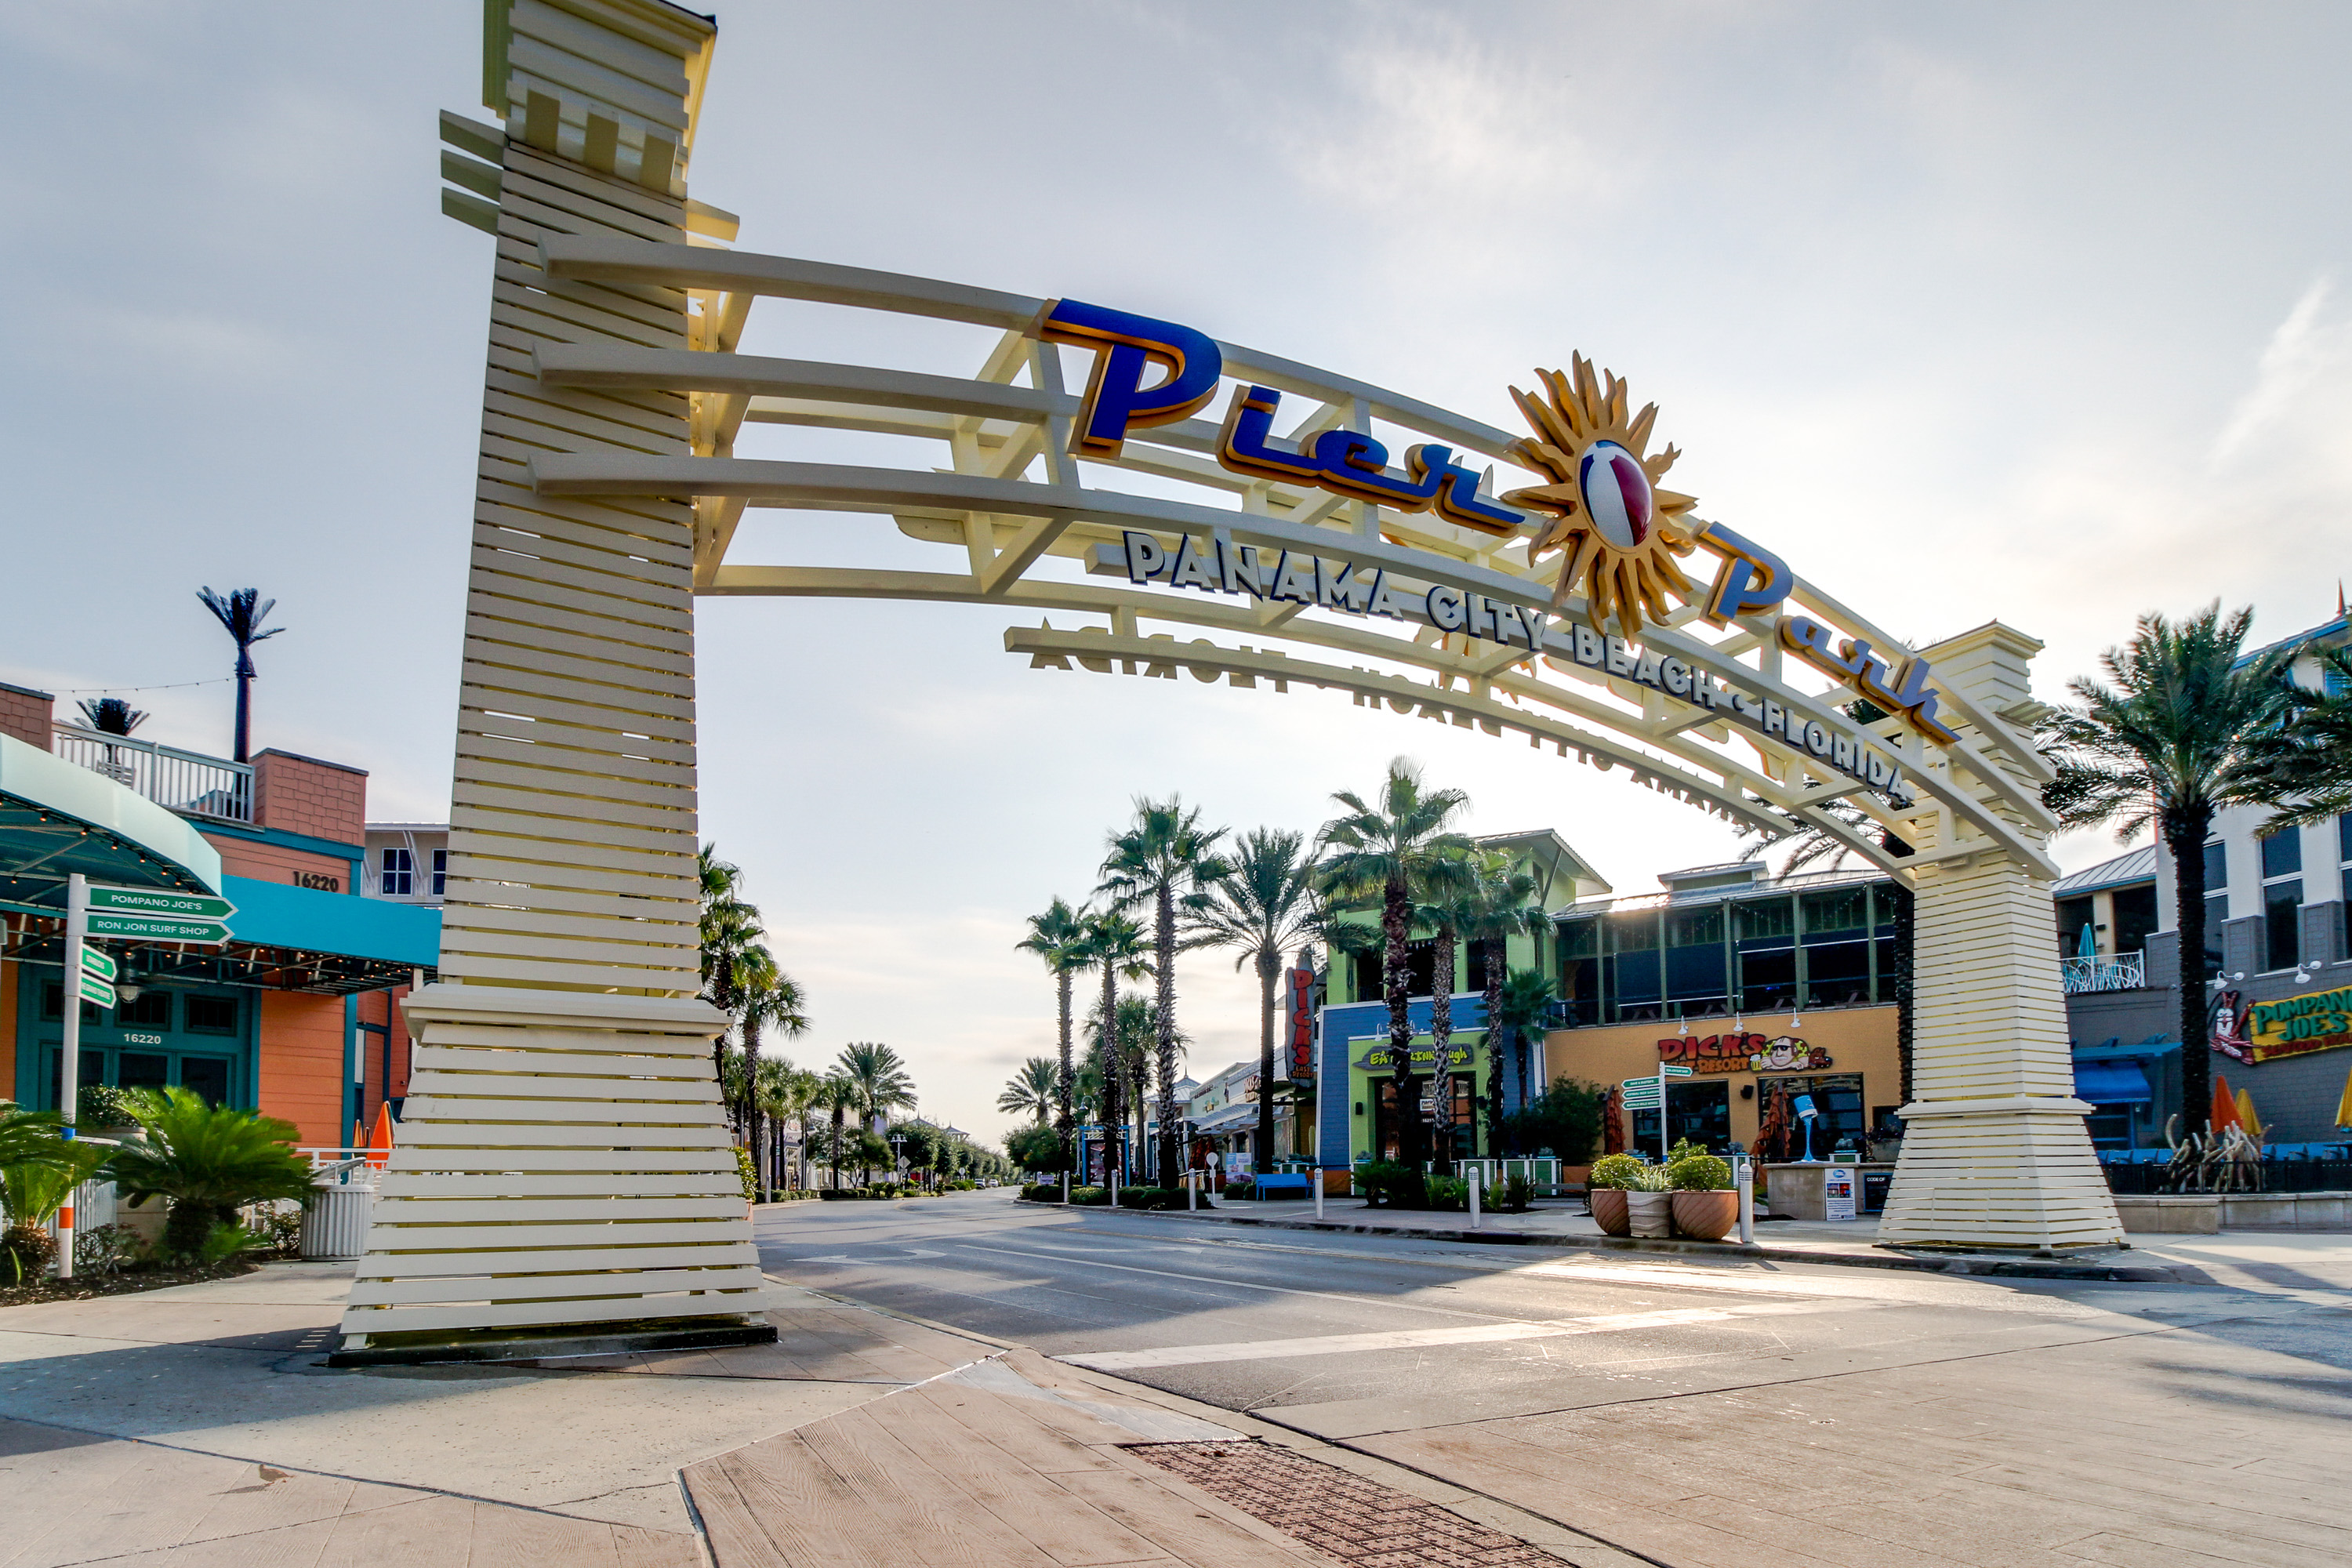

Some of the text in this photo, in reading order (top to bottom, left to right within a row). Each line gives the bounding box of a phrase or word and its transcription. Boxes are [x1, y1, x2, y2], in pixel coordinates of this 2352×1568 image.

[1044, 298, 1962, 744] Pier Park
[1123, 531, 1404, 622] PANAMA
[1427, 586, 1548, 652] CITY
[1573, 622, 1717, 709] BEACH
[1762, 696, 1916, 804] FLORIDA
[293, 871, 339, 893] 16220
[111, 895, 202, 910] POMPANO JOE'S
[97, 920, 209, 935] RON JON SURF SHOP
[1292, 970, 1315, 1065] DICK'S
[124, 1033, 162, 1044] 16220
[1657, 1032, 1766, 1061] DICK'S
[1447, 1047, 1468, 1064] ugh
[1697, 1058, 1750, 1073] RESORT
